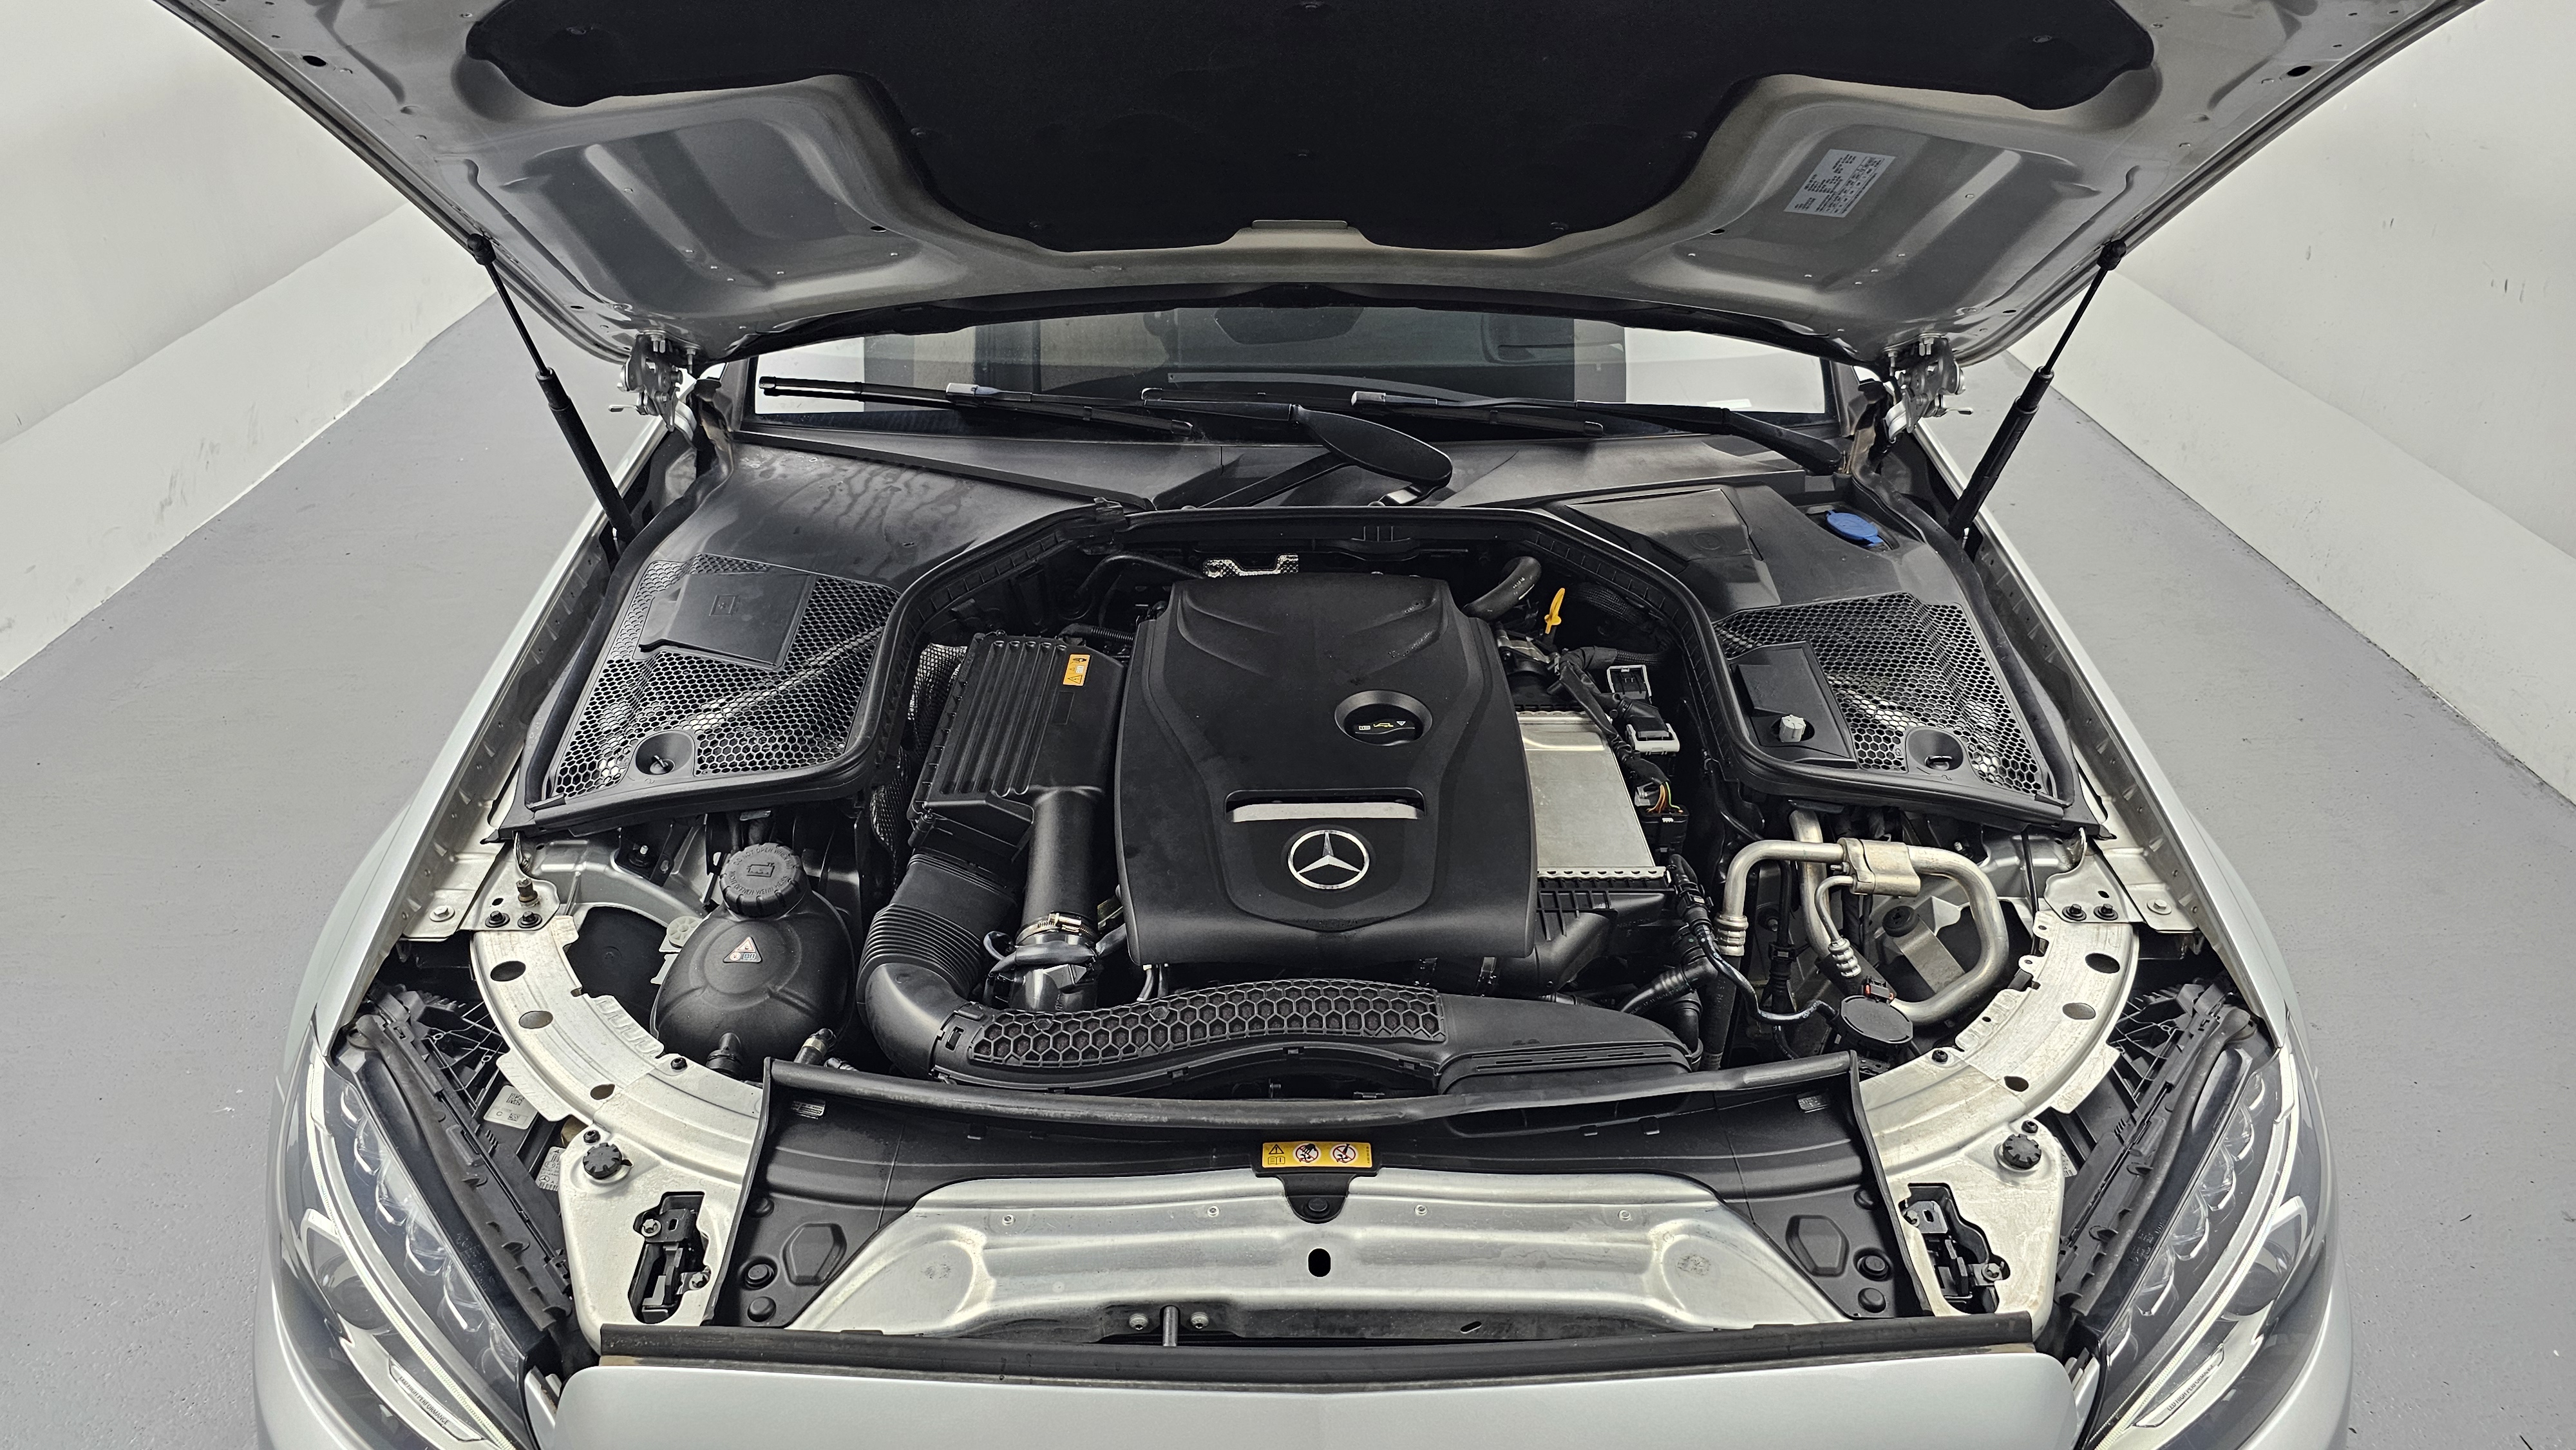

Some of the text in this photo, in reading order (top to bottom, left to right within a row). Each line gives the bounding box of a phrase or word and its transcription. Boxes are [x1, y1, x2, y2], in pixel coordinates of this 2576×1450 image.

[399, 1376, 450, 1425] LED HIGH PERFORMANCE
[2166, 1402, 2177, 1411] LED
[2175, 1393, 2188, 1404] HIGH
